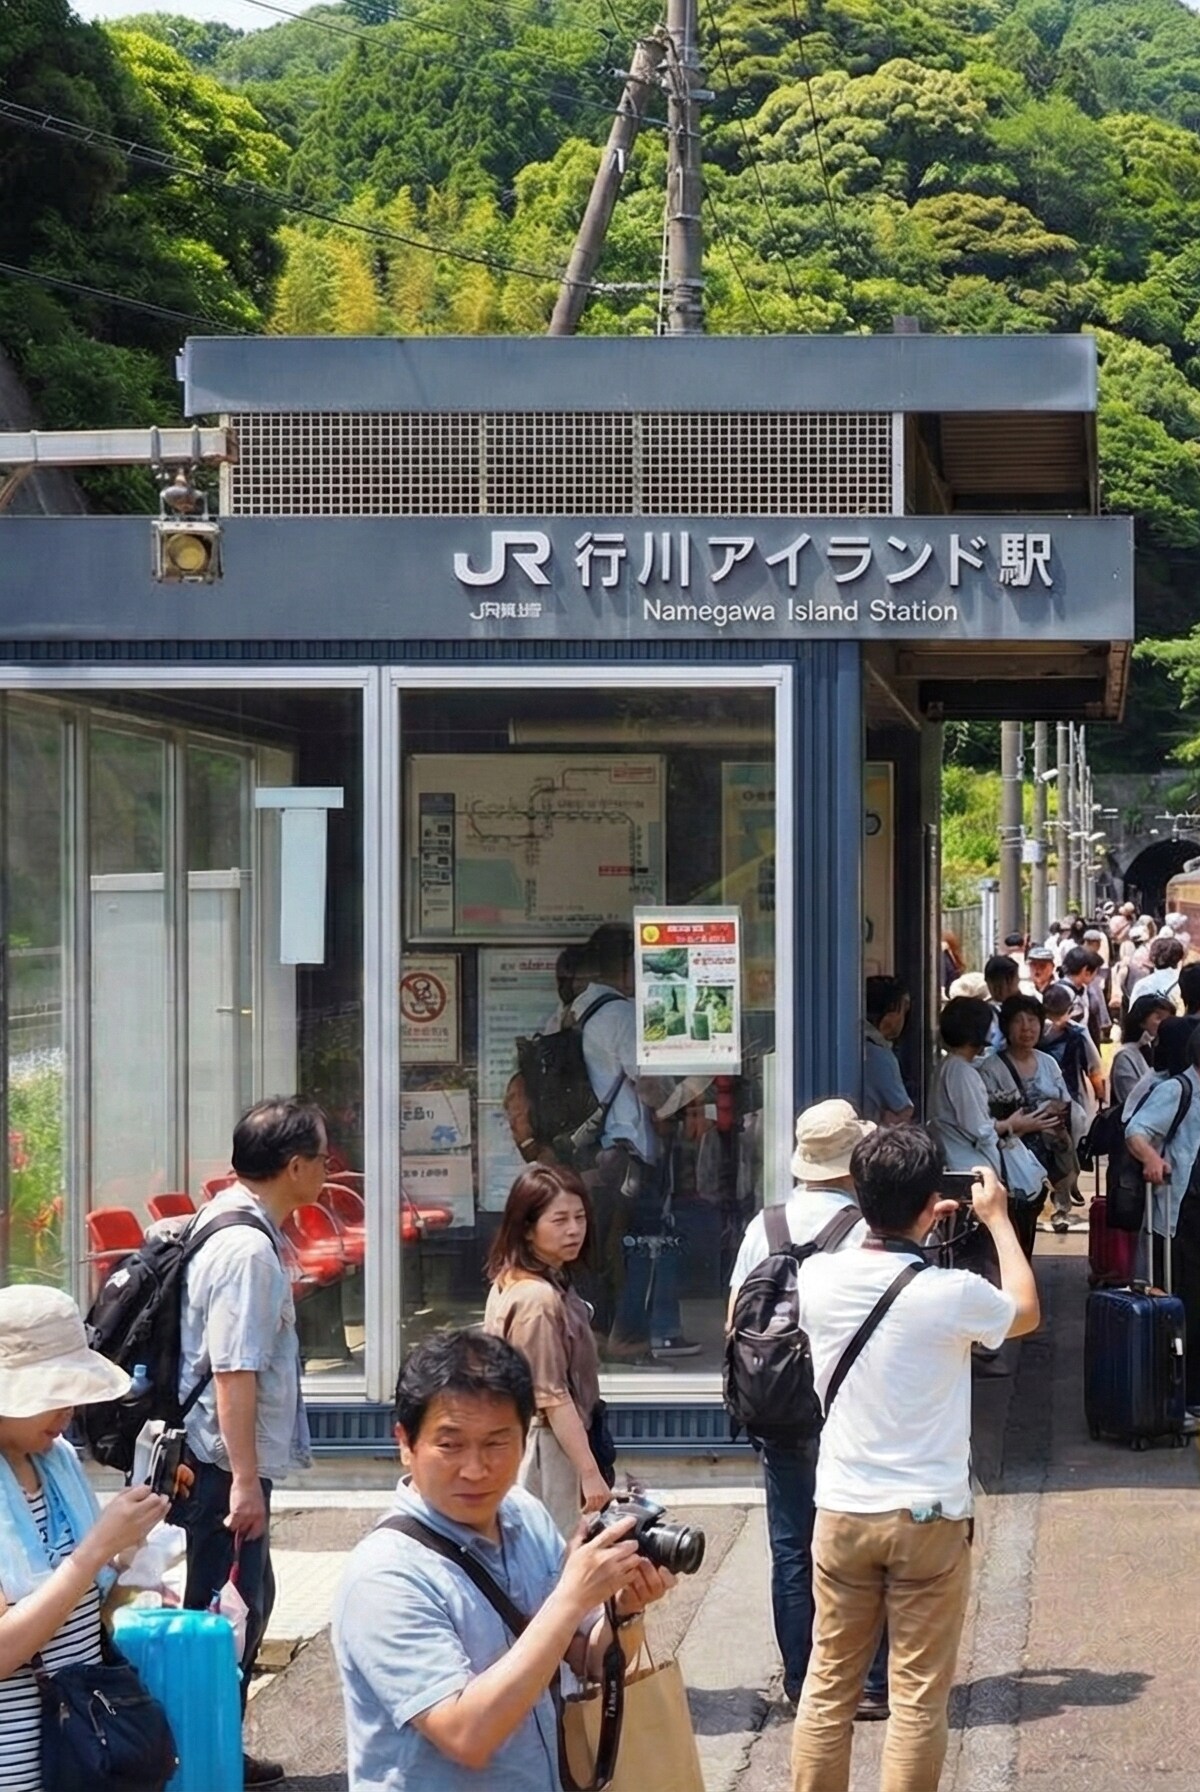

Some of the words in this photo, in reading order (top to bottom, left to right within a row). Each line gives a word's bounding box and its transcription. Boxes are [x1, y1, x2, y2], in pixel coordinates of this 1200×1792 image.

[453, 530, 551, 586] JR
[574, 531, 1053, 587] 行川アイランド駅
[643, 598, 776, 627] Namegawa
[787, 598, 858, 621] Island
[869, 598, 958, 621] Station
